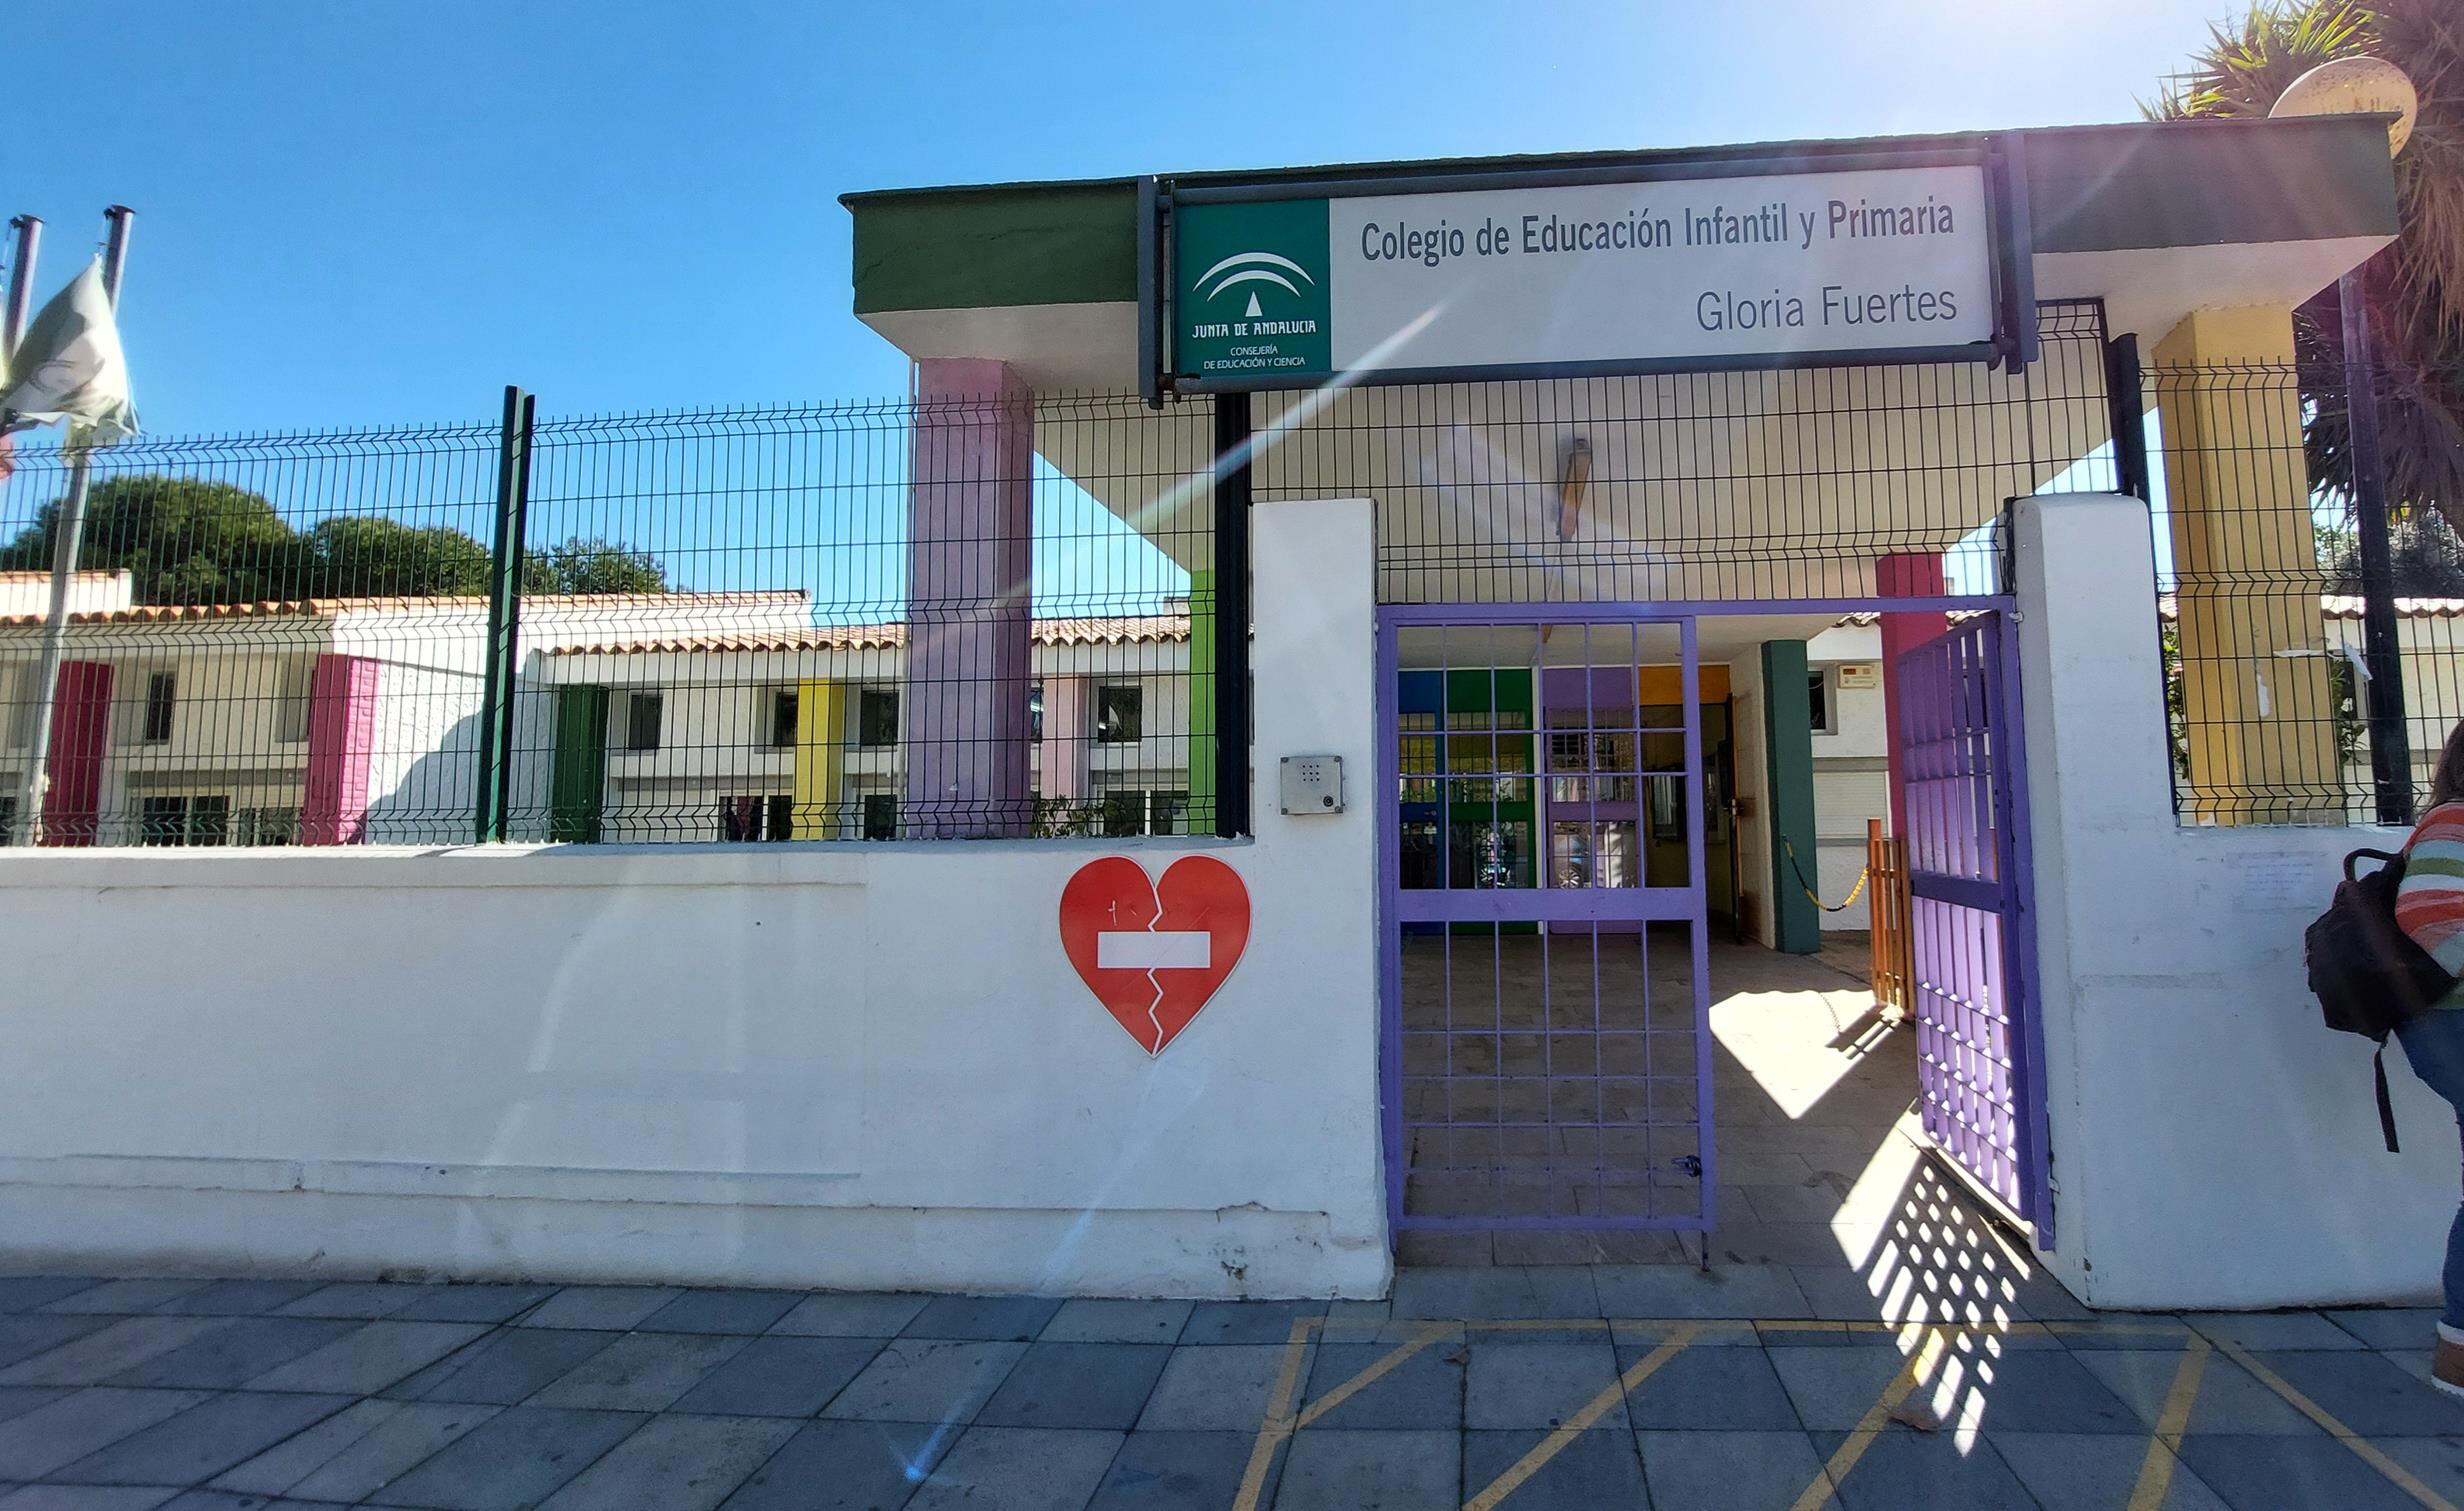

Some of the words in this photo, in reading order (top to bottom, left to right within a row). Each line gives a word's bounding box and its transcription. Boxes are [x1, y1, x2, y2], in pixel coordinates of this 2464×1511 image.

[1361, 219, 1465, 267] Colegio
[1476, 217, 1510, 256] de
[1522, 208, 1673, 254] Educación
[1684, 203, 1789, 246] Infantil
[1799, 211, 1817, 250] y
[1827, 194, 1955, 239] Primaria
[1697, 287, 1804, 331] Gloria
[1821, 284, 1958, 326] Fuertes
[1192, 324, 1229, 338] JUNTA
[1234, 323, 1249, 337] DE
[1230, 344, 1278, 356] CONSEJERÍA
[1203, 361, 1216, 369] DE
[1217, 357, 1266, 368] EDUCACIÓN
[1266, 358, 1273, 367] Y
[1273, 356, 1306, 367] CIENCIA
